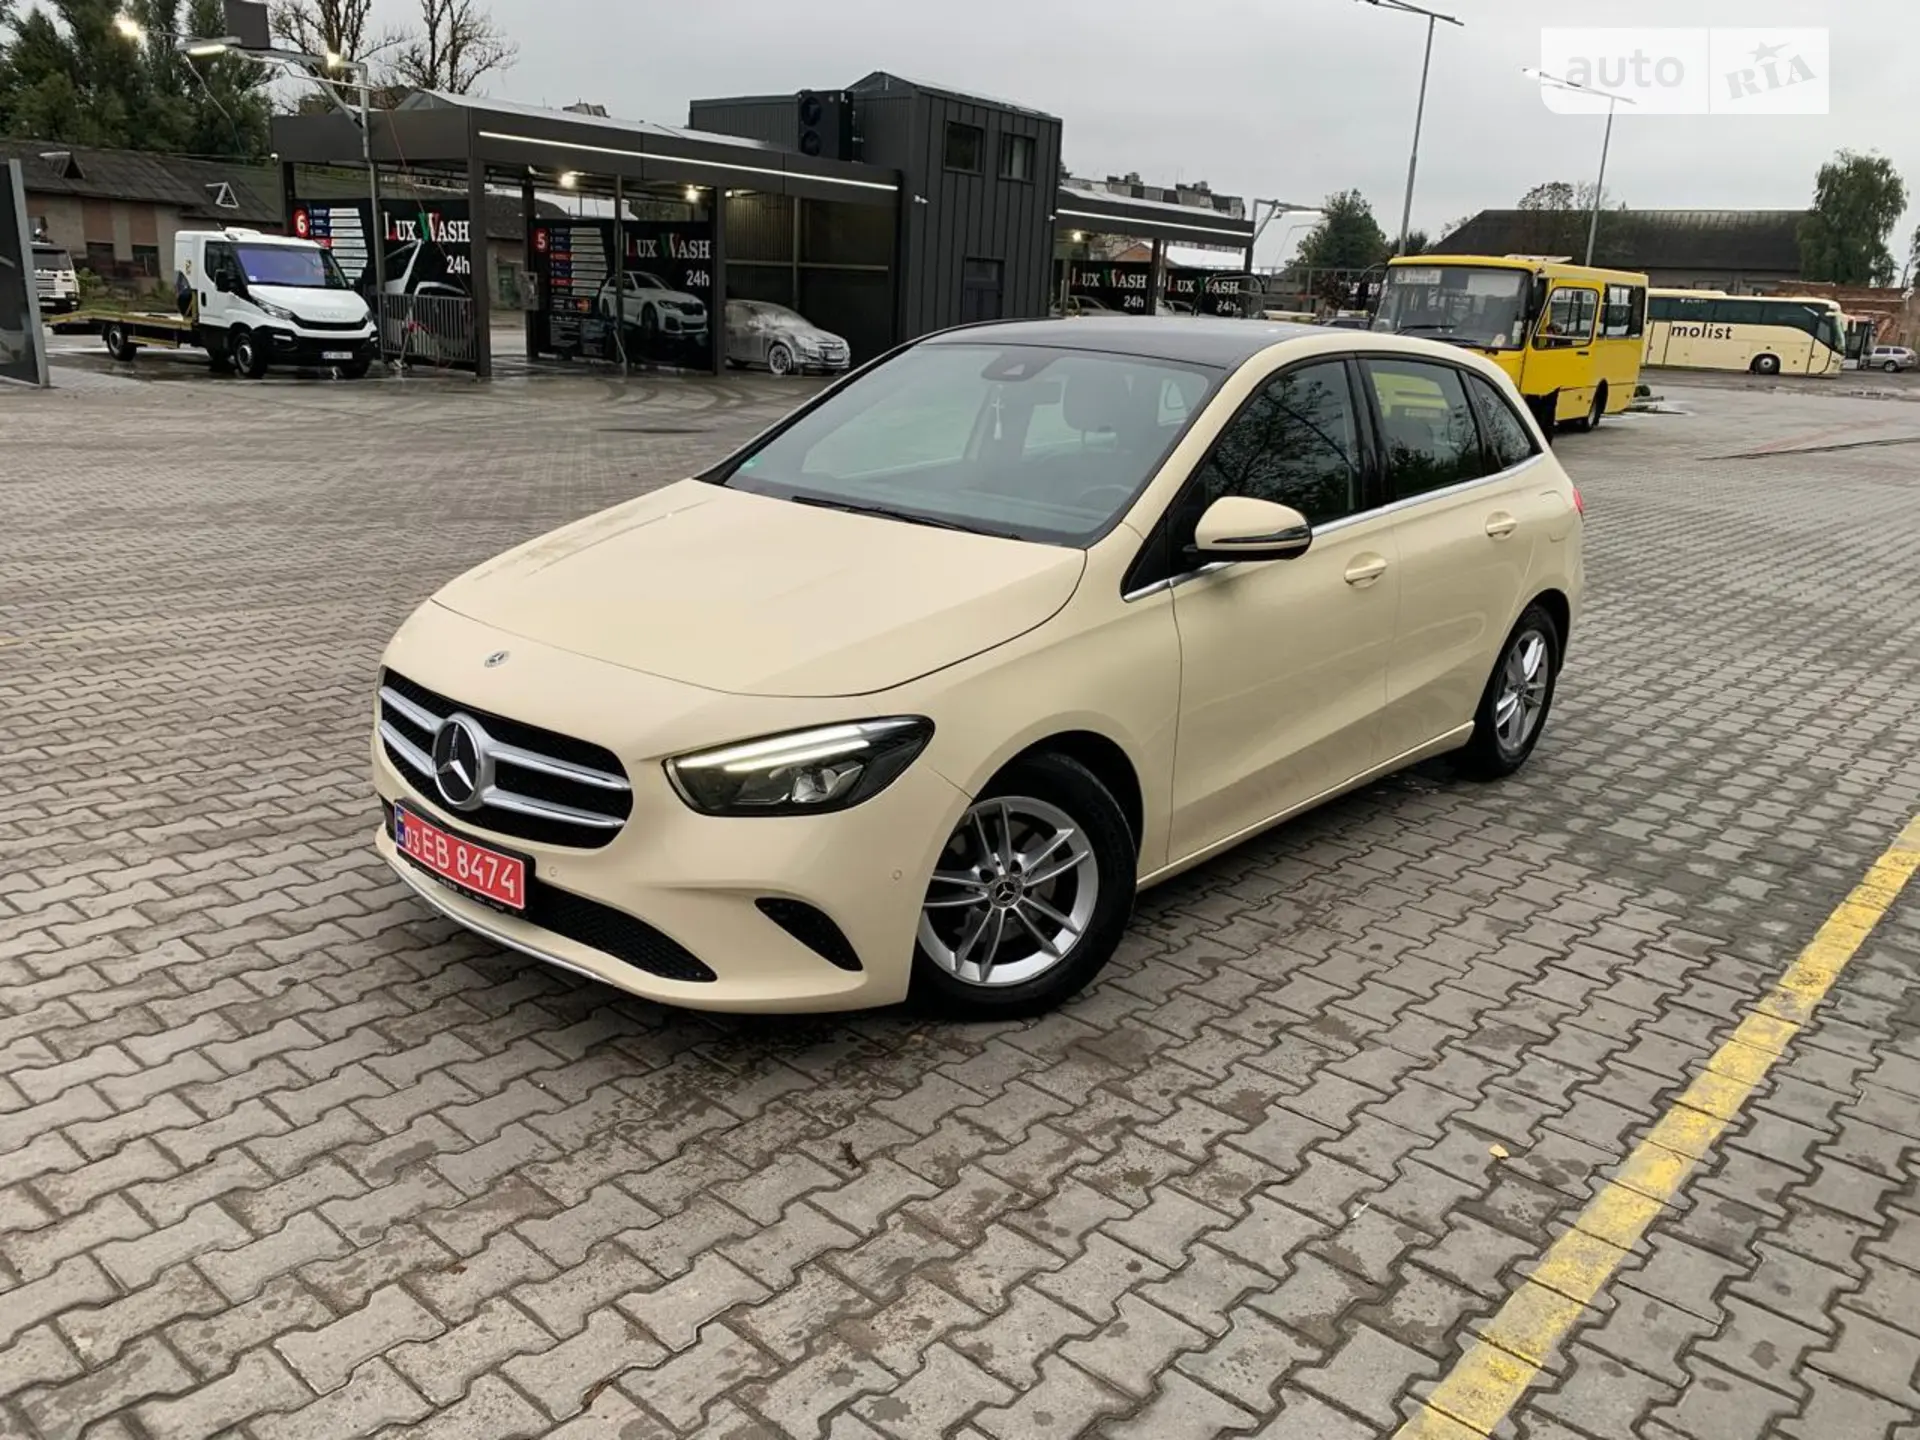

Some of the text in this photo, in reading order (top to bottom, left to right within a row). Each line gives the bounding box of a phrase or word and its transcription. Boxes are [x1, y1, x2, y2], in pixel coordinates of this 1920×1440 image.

[296, 214, 306, 233] 6
[384, 211, 470, 242] LUX WASH
[537, 232, 546, 249] 5
[625, 232, 711, 259] LUX WASH
[446, 255, 470, 274] 24h
[686, 270, 710, 287] 24h
[1072, 266, 1100, 287] LUX
[1103, 268, 1147, 289] WASH
[1124, 295, 1144, 308] 24h
[1670, 323, 1733, 340] molist
[456, 845, 515, 898] 8474
